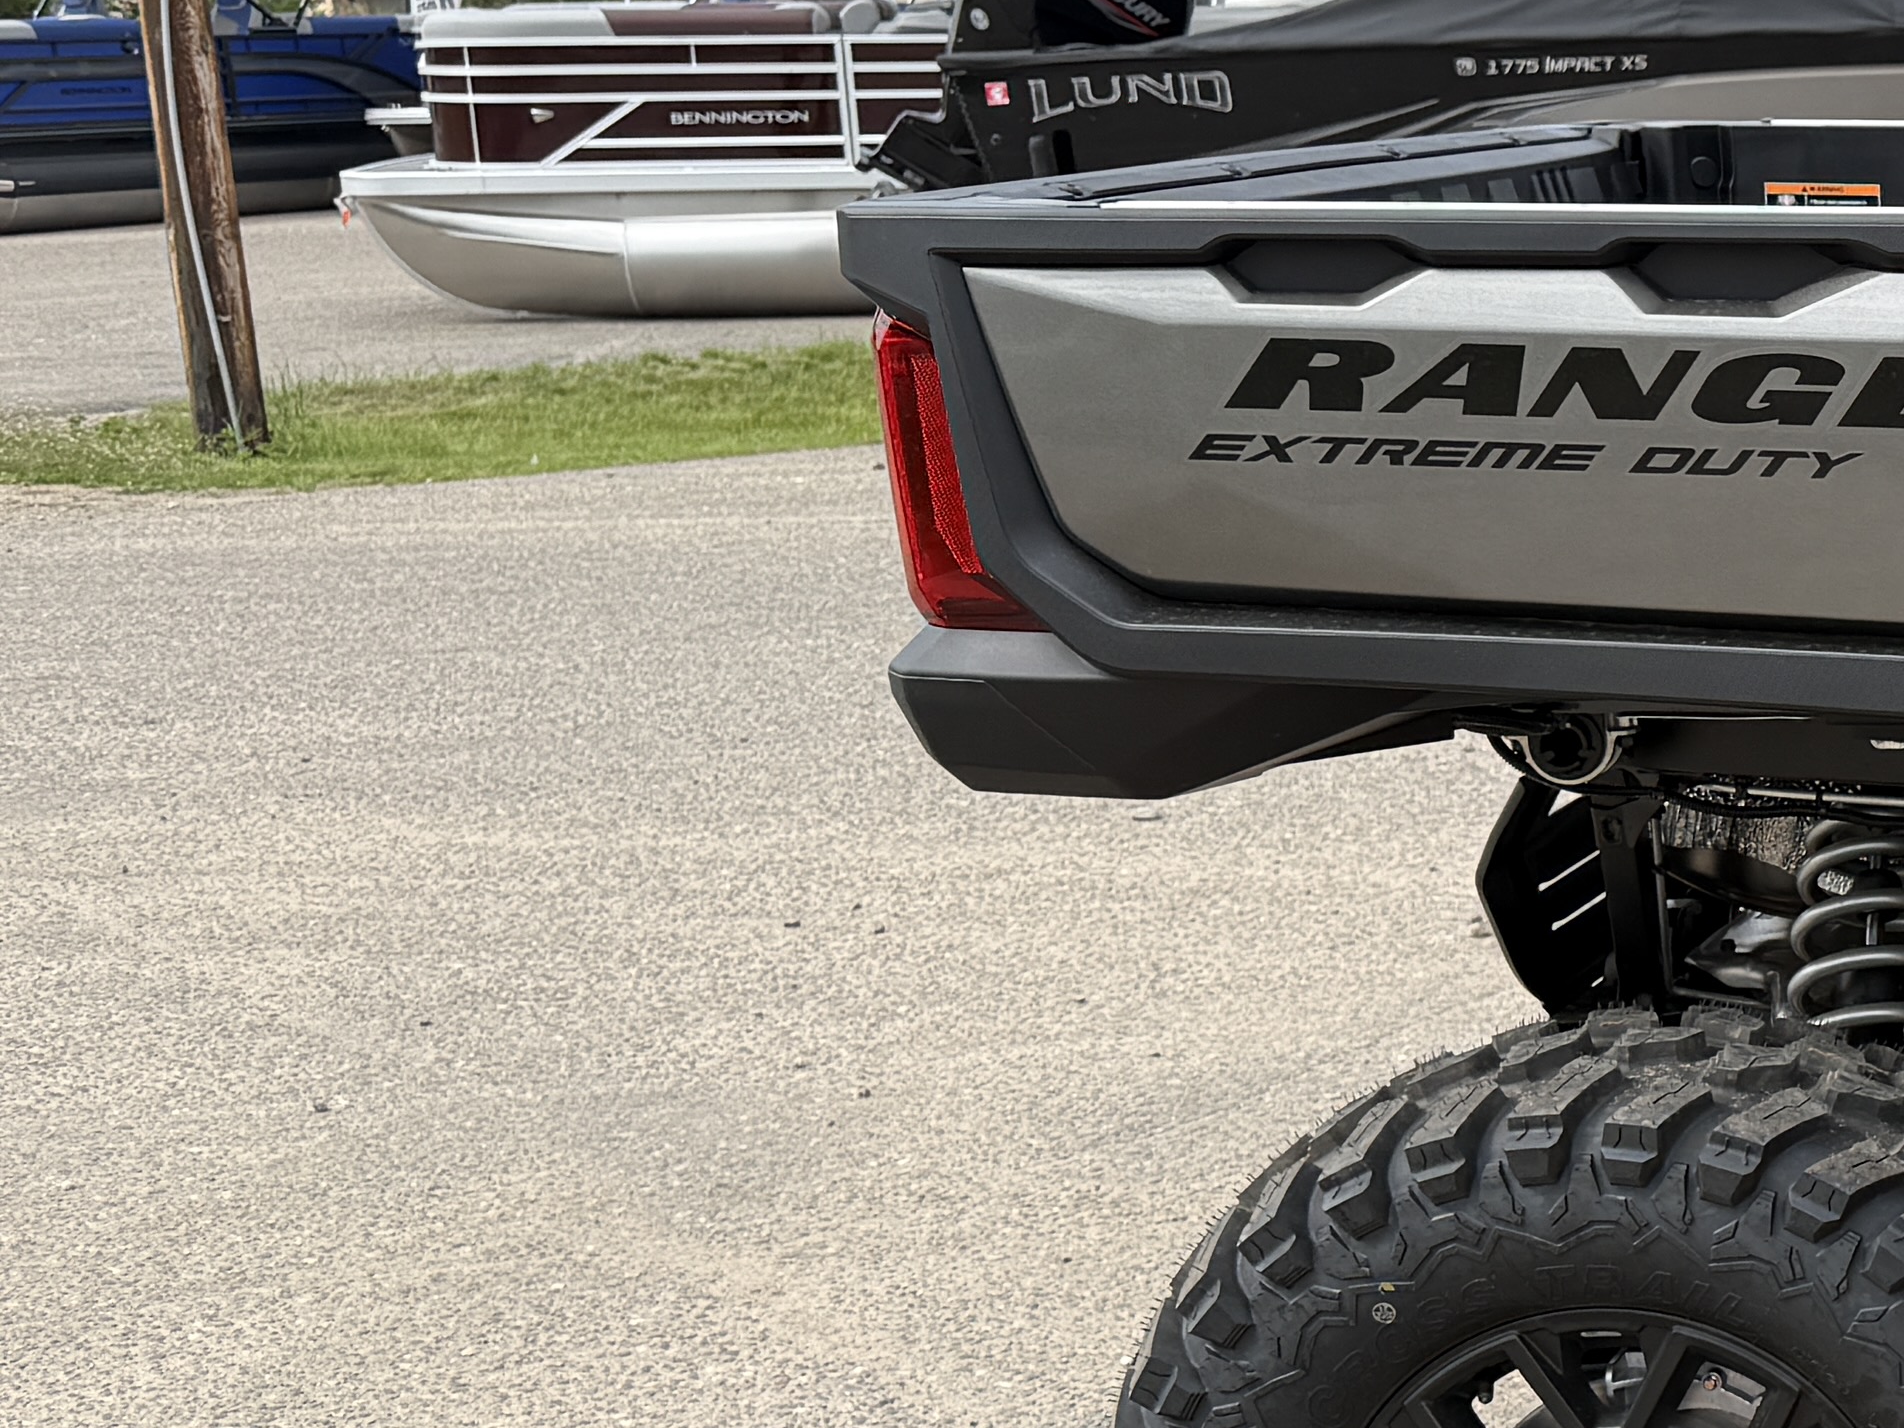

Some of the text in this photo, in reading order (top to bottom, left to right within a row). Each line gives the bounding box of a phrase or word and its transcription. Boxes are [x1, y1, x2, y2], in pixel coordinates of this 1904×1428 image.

[1544, 56, 1616, 74] IMPACT
[1621, 54, 1648, 71] XS
[670, 109, 810, 126] BENNINGTON
[1027, 70, 1233, 123] LUND
[1187, 433, 1867, 480] EXTREME DUTY
[1536, 1264, 1753, 1329] TRAIL
